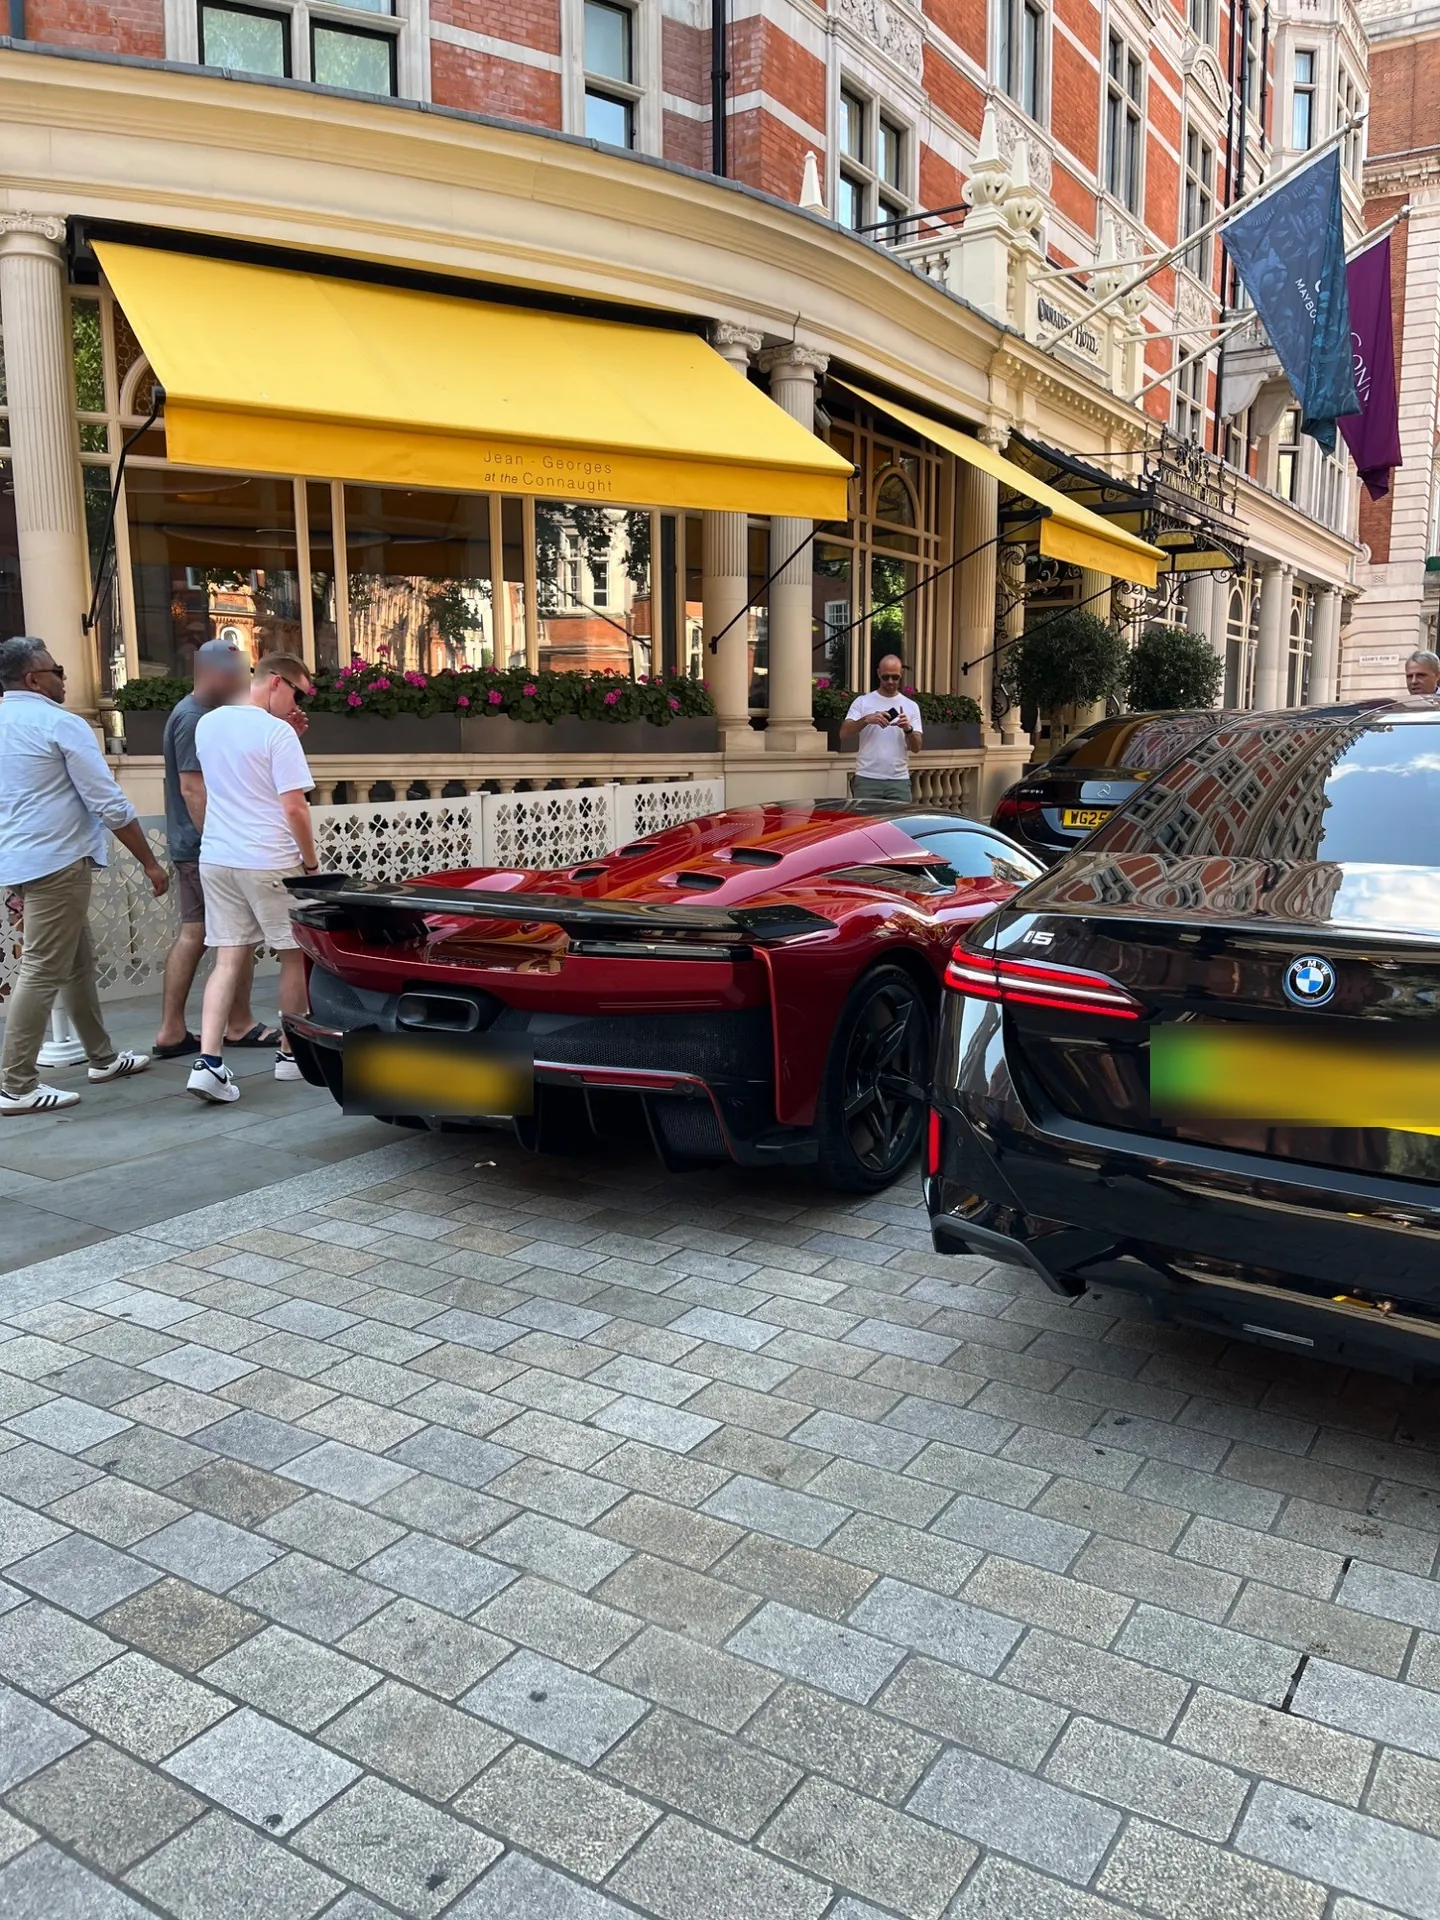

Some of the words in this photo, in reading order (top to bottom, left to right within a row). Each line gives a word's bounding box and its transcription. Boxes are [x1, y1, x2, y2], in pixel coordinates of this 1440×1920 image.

[1294, 278, 1318, 325] MAYBO
[484, 450, 524, 466] Jean
[542, 455, 612, 475] Georges
[484, 473, 496, 482] at
[500, 473, 518, 484] the
[522, 472, 612, 493] Connaught
[1022, 930, 1055, 946] i5
[1293, 960, 1330, 975] BMW
